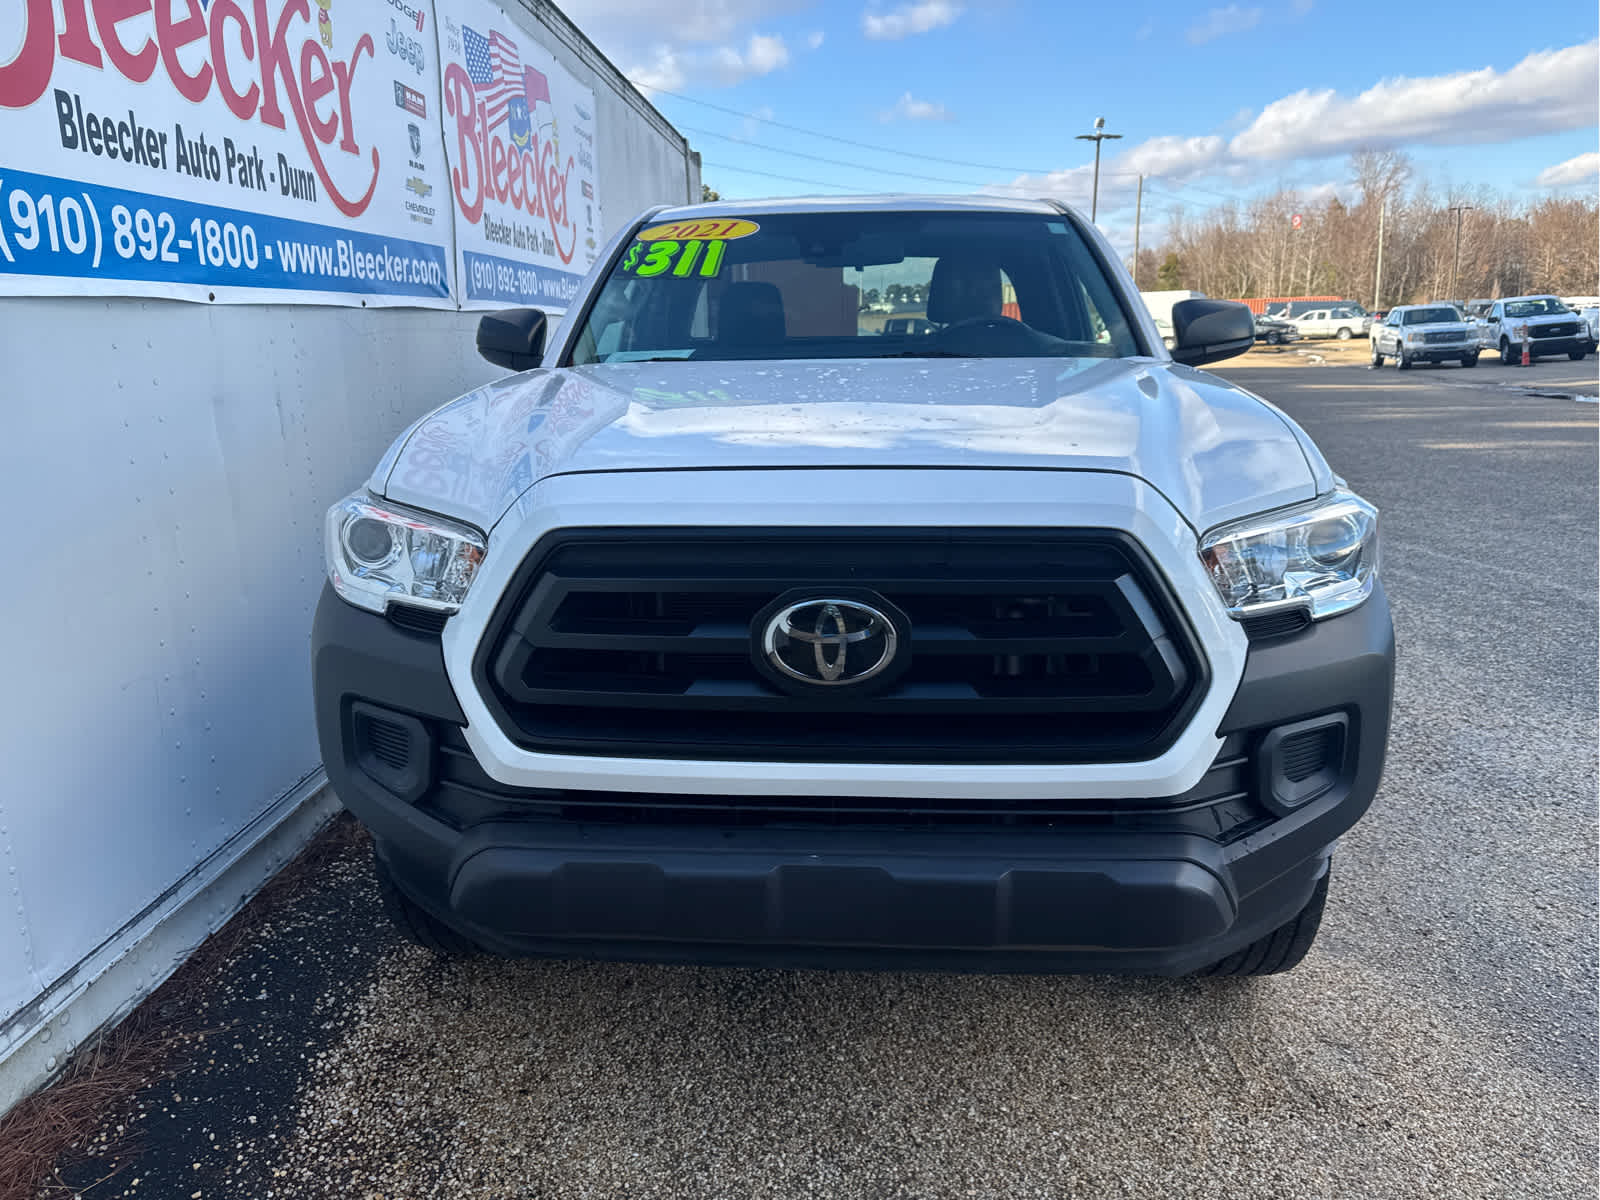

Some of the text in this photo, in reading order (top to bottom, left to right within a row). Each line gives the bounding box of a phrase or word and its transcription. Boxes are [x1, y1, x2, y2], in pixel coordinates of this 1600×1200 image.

[385, 17, 425, 76] Jeep
[0, 0, 381, 218] eecker
[54, 88, 167, 170] Bleecker
[175, 123, 221, 182] Auto
[224, 137, 267, 192] Park
[277, 152, 317, 202] Dunn
[445, 63, 576, 265] Bleecker
[405, 200, 436, 217] CHEVROLET
[484, 212, 513, 247] Bleecker
[513, 221, 526, 250] Auto
[526, 226, 539, 253] Park
[542, 231, 556, 256] Dunn
[657, 221, 740, 240] 2021
[111, 204, 259, 270] 892-1800
[276, 238, 441, 286] www.Bleecker.com
[623, 239, 727, 278] $311
[471, 257, 497, 297] (910)
[497, 265, 538, 296] 892-1800
